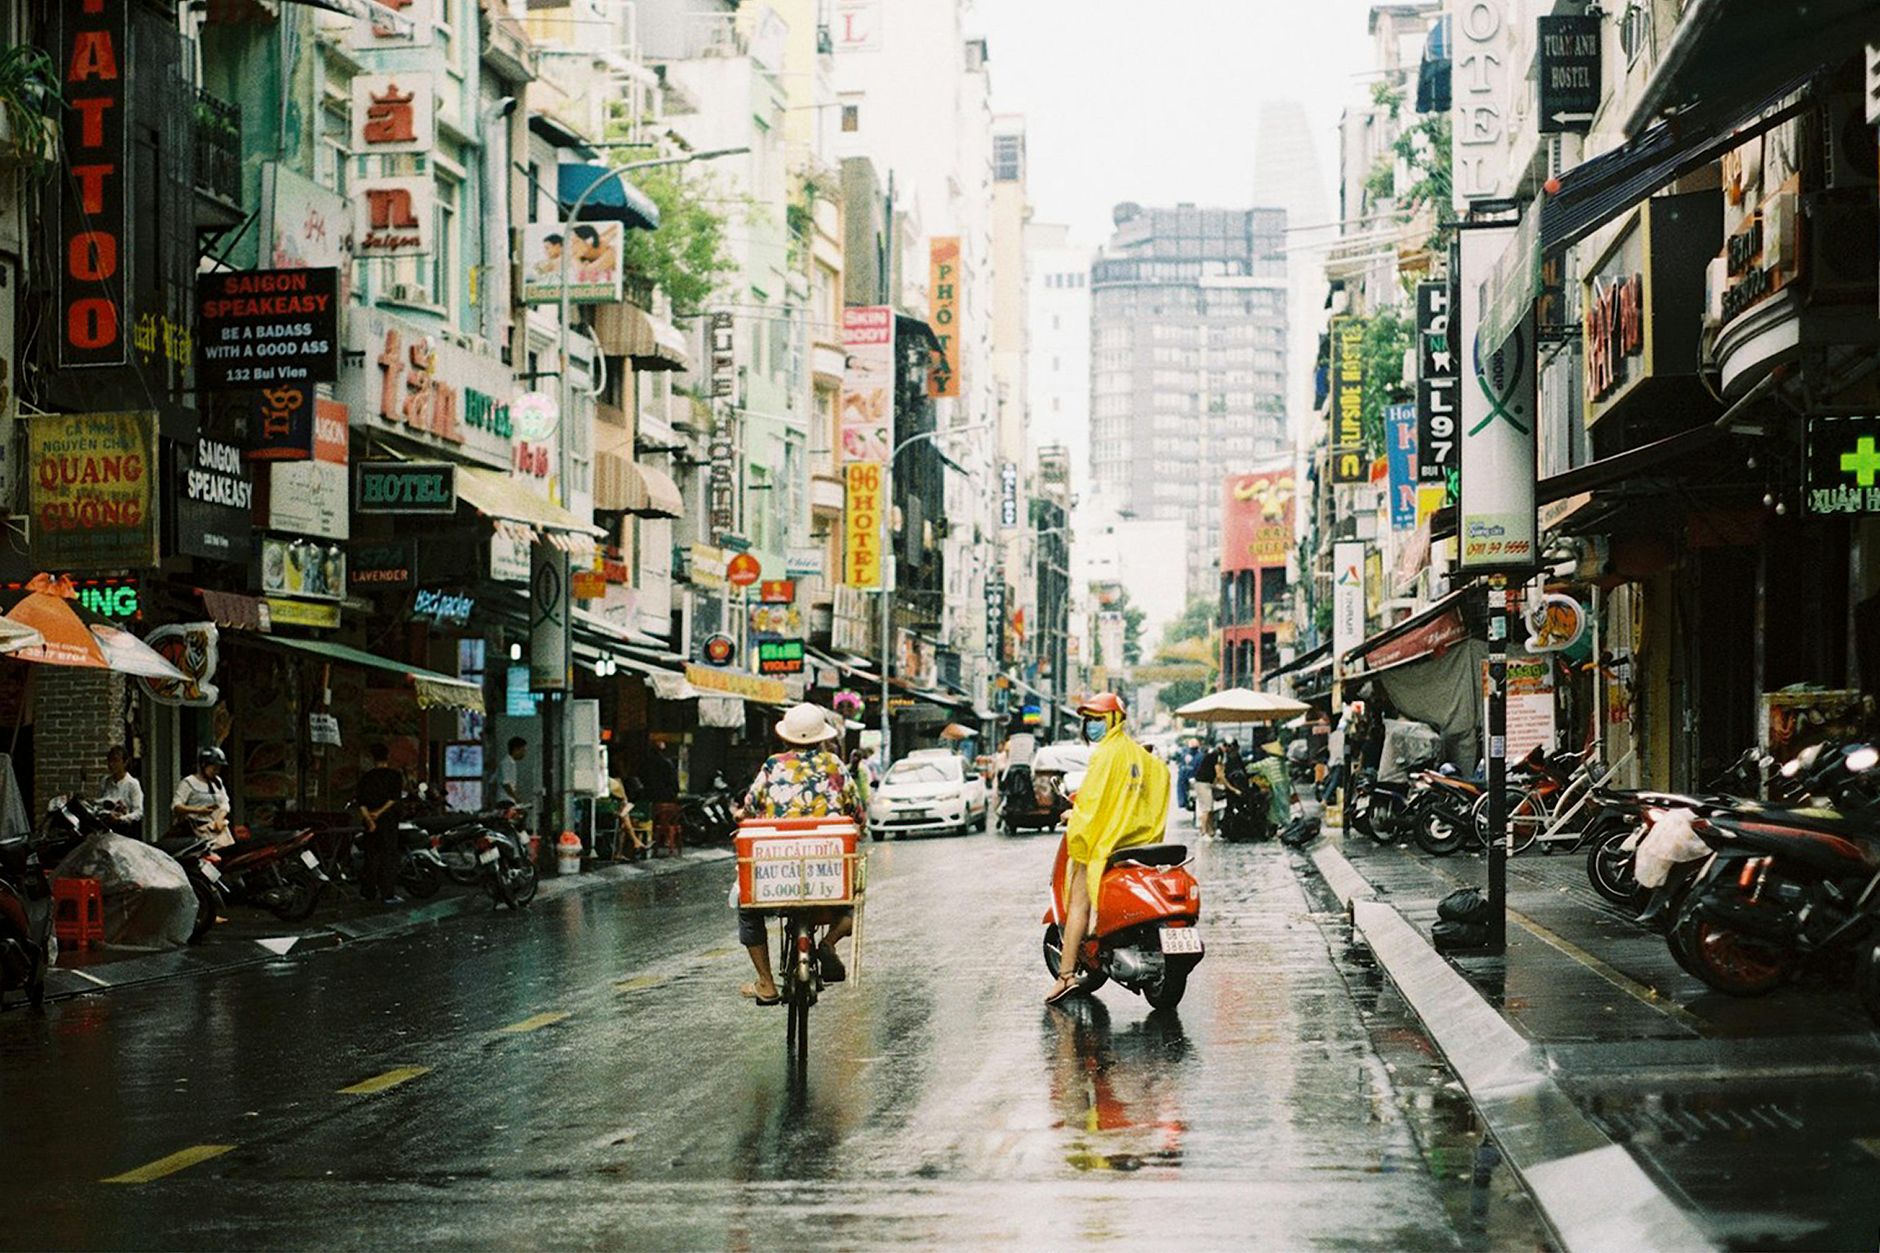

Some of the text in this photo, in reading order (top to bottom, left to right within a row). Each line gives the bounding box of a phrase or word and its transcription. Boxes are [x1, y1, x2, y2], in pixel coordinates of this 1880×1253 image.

[1551, 66, 1590, 88] HOSTEL
[225, 273, 307, 294] SAIGON
[202, 293, 329, 319] SPEAKEASY
[221, 322, 313, 340] BE A BADASS
[205, 339, 329, 359] WITH A GOOD ASS
[226, 368, 250, 381] 132
[254, 367, 275, 380] Bui
[199, 438, 240, 476] SAIGON
[40, 454, 143, 491] QUANG
[850, 465, 879, 492] 96
[188, 468, 252, 509] SPEAKEASY
[363, 473, 450, 503] HOTEL
[1811, 484, 1862, 514] XUÂN
[853, 494, 874, 584] HOTEL
[352, 569, 408, 583] LAVENDER
[762, 660, 803, 672] VIOLET
[755, 864, 778, 879] RAU
[807, 865, 815, 877] 3
